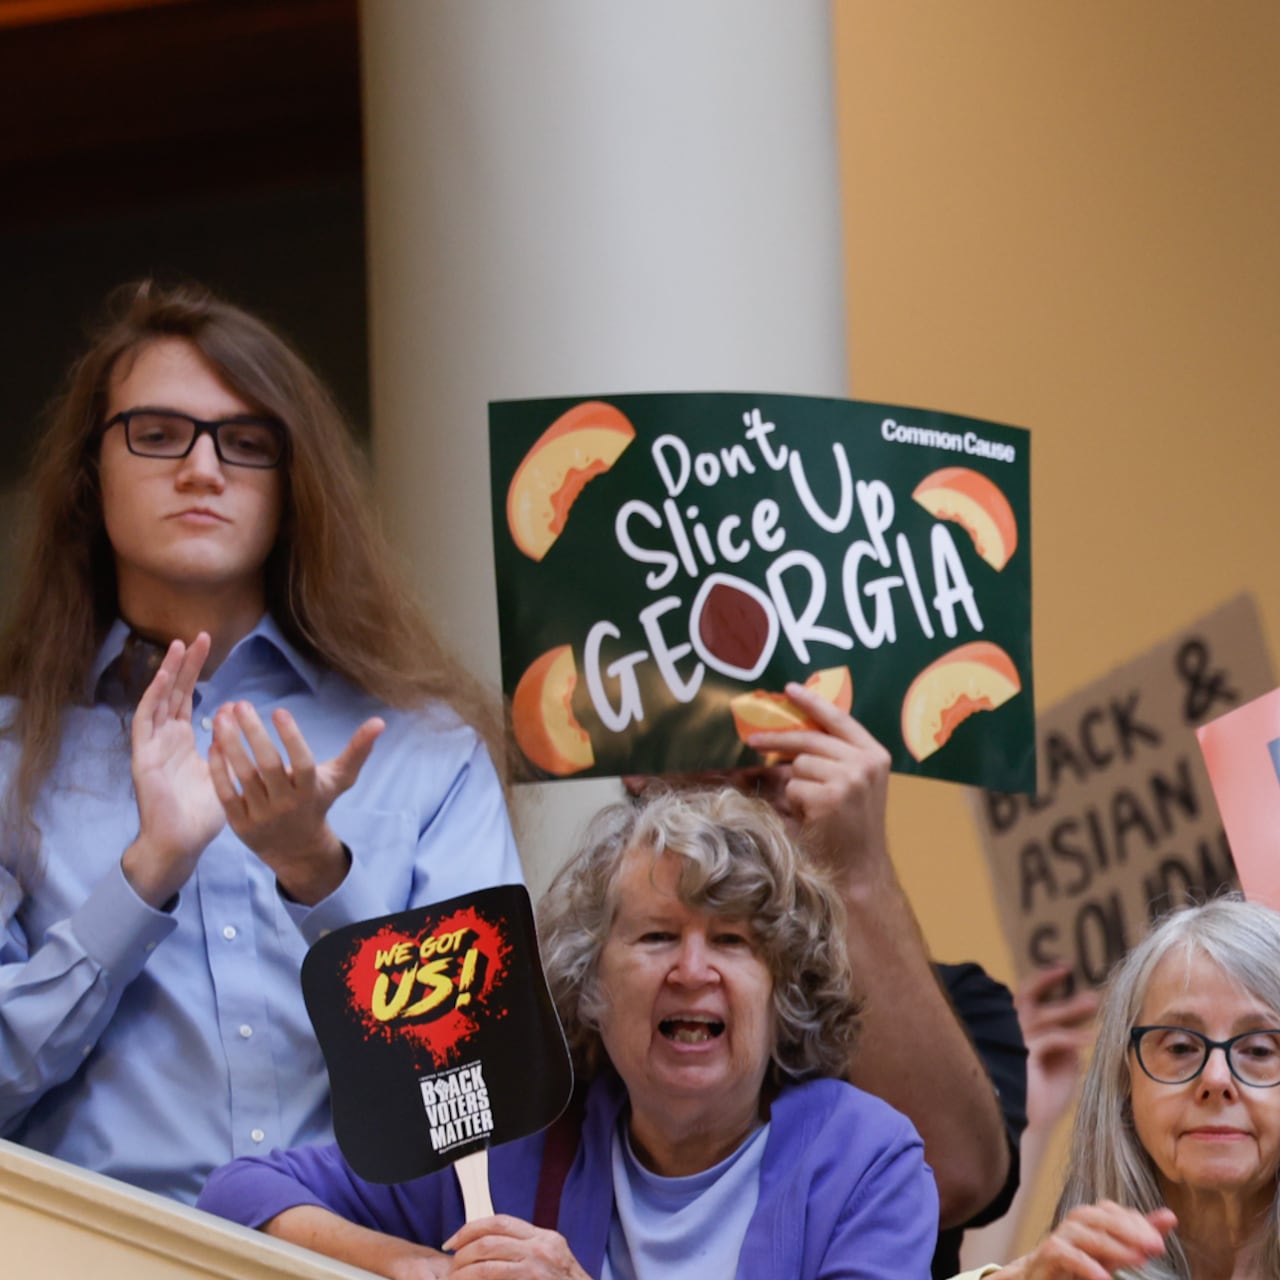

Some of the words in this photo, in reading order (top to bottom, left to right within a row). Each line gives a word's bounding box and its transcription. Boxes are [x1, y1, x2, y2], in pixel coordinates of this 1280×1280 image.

[652, 409, 788, 497] Don't
[615, 499, 786, 589] Slice
[789, 442, 895, 566] Up
[584, 523, 983, 732] GEORGIA
[1019, 755, 1199, 912] ASIAN
[372, 948, 478, 1021] US!
[374, 942, 415, 970] WE
[420, 927, 470, 958] GOT
[425, 1088, 490, 1128] VOTERS
[430, 1109, 494, 1151] MATTER
